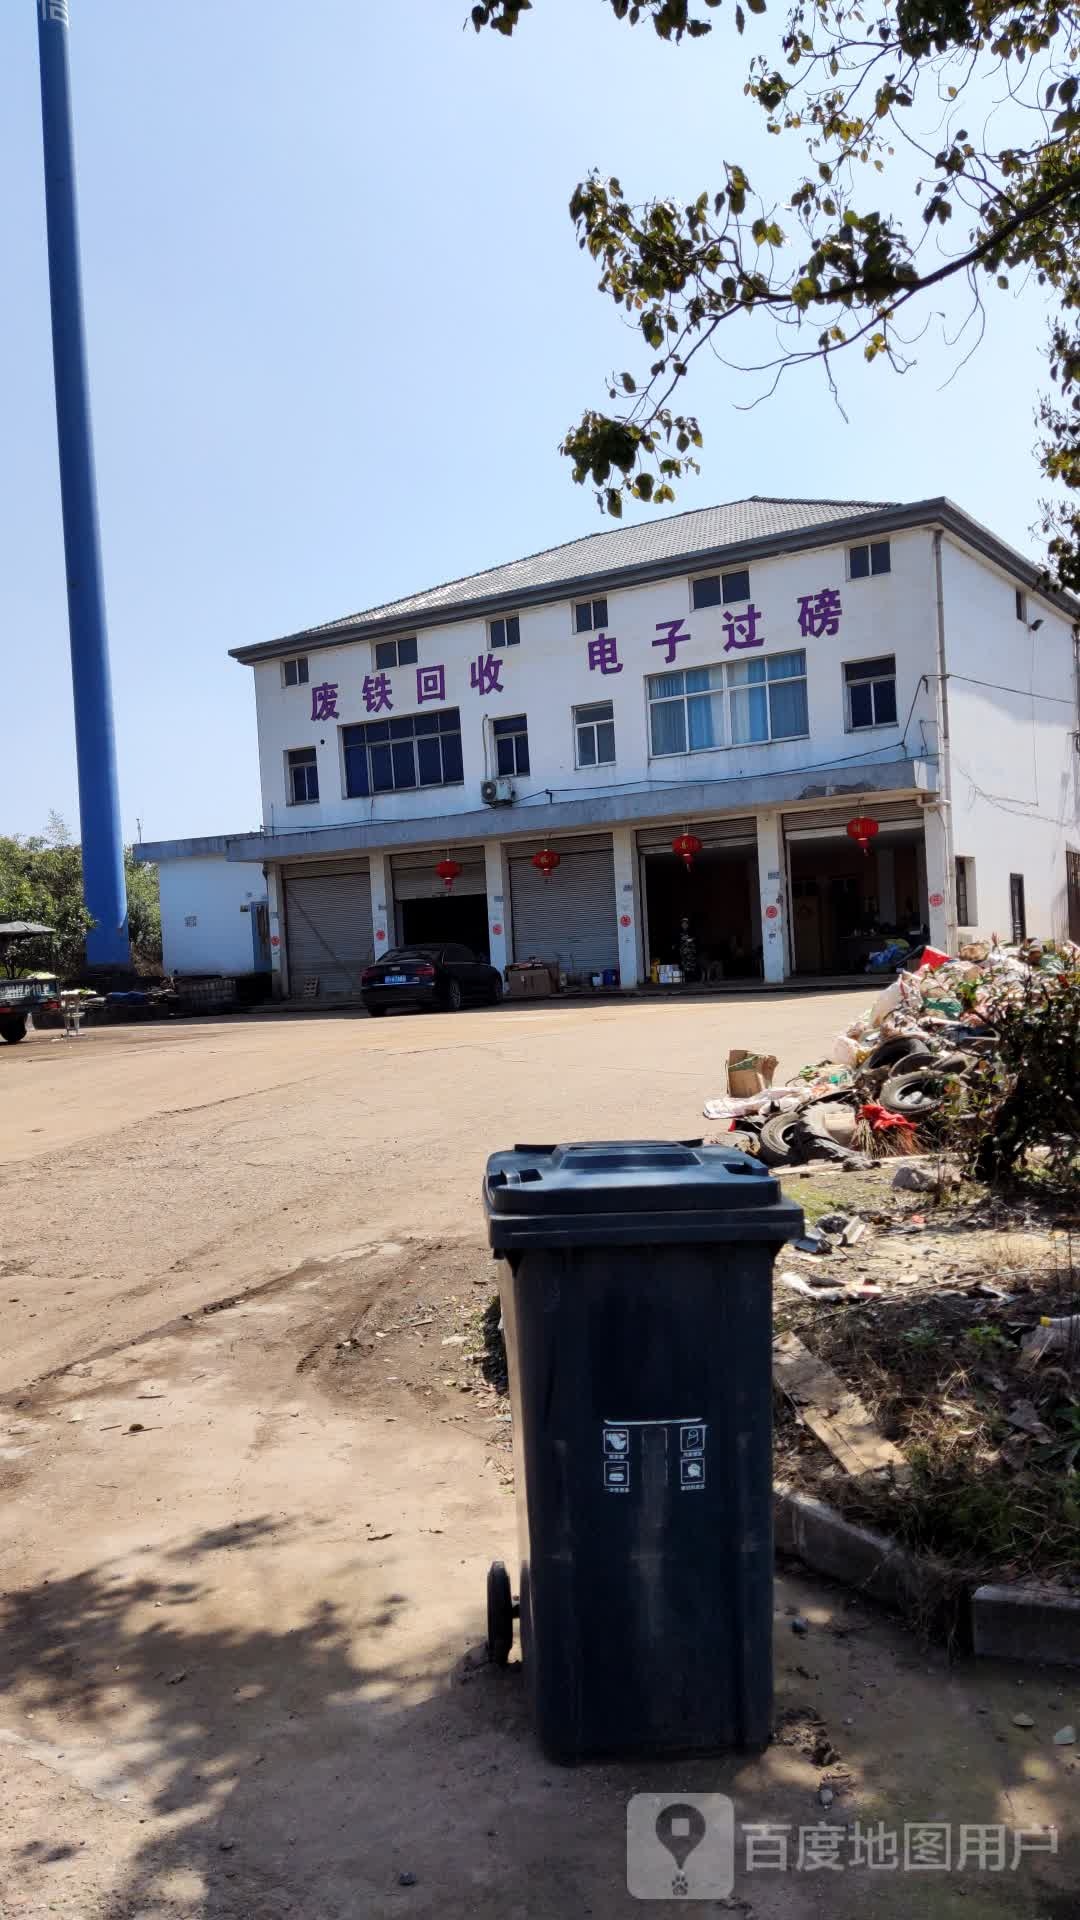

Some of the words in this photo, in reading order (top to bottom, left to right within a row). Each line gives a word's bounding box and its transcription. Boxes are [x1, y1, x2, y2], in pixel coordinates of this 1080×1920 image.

[310, 653, 505, 721] 废铁回收
[587, 588, 843, 675] 电子过磅
